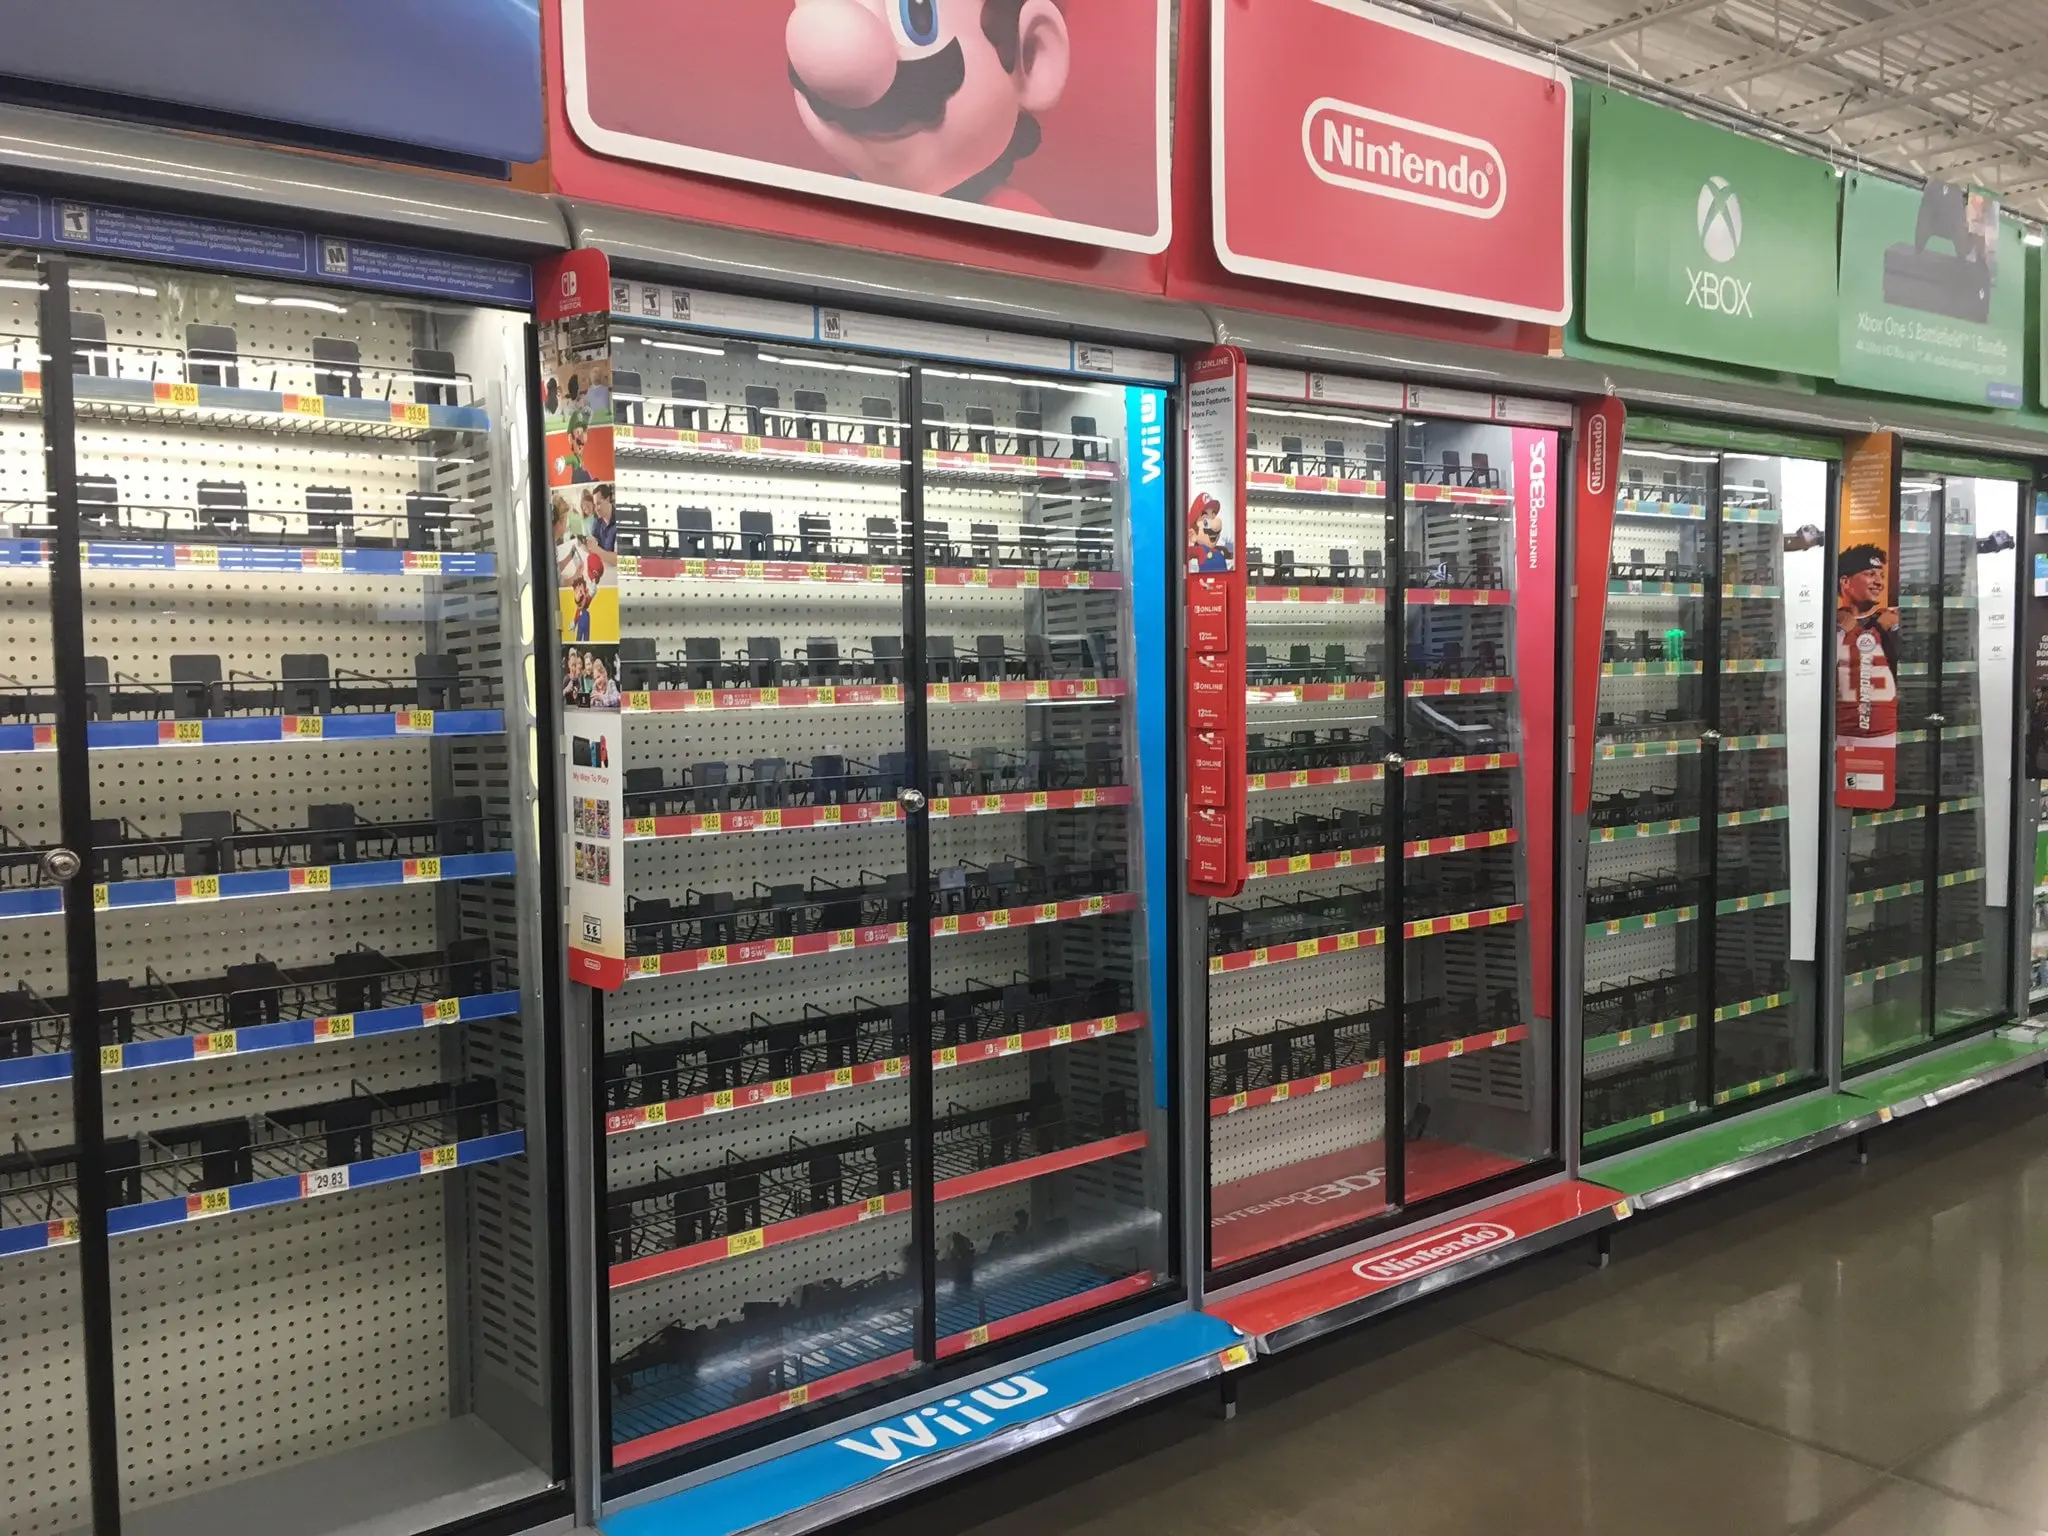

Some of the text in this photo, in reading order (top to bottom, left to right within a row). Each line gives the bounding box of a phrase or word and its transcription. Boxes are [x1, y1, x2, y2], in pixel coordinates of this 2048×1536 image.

[1322, 118, 1492, 199] Nintendo
[1684, 266, 1754, 319] XBOX
[1591, 420, 1603, 488] Nintendo
[1199, 682, 1223, 691] ONLINE
[300, 718, 320, 733] 29.83
[412, 712, 431, 727] 19.93
[637, 819, 653, 833] 49.94
[420, 861, 438, 875] 9.93
[308, 870, 328, 884] 29.83
[195, 878, 217, 894] 19.93
[710, 948, 725, 963] 49.94
[642, 956, 658, 971] 49.94
[437, 1001, 456, 1017] 19.93
[330, 1018, 350, 1033] 29.83
[885, 1060, 899, 1075] 49.94
[836, 1069, 851, 1083] 49.94
[775, 1080, 790, 1095] 49.94
[715, 1092, 732, 1107] 49.94
[647, 1105, 664, 1120] 49.94
[316, 1171, 344, 1189] 29.83
[1367, 1229, 1499, 1277] Nintendo
